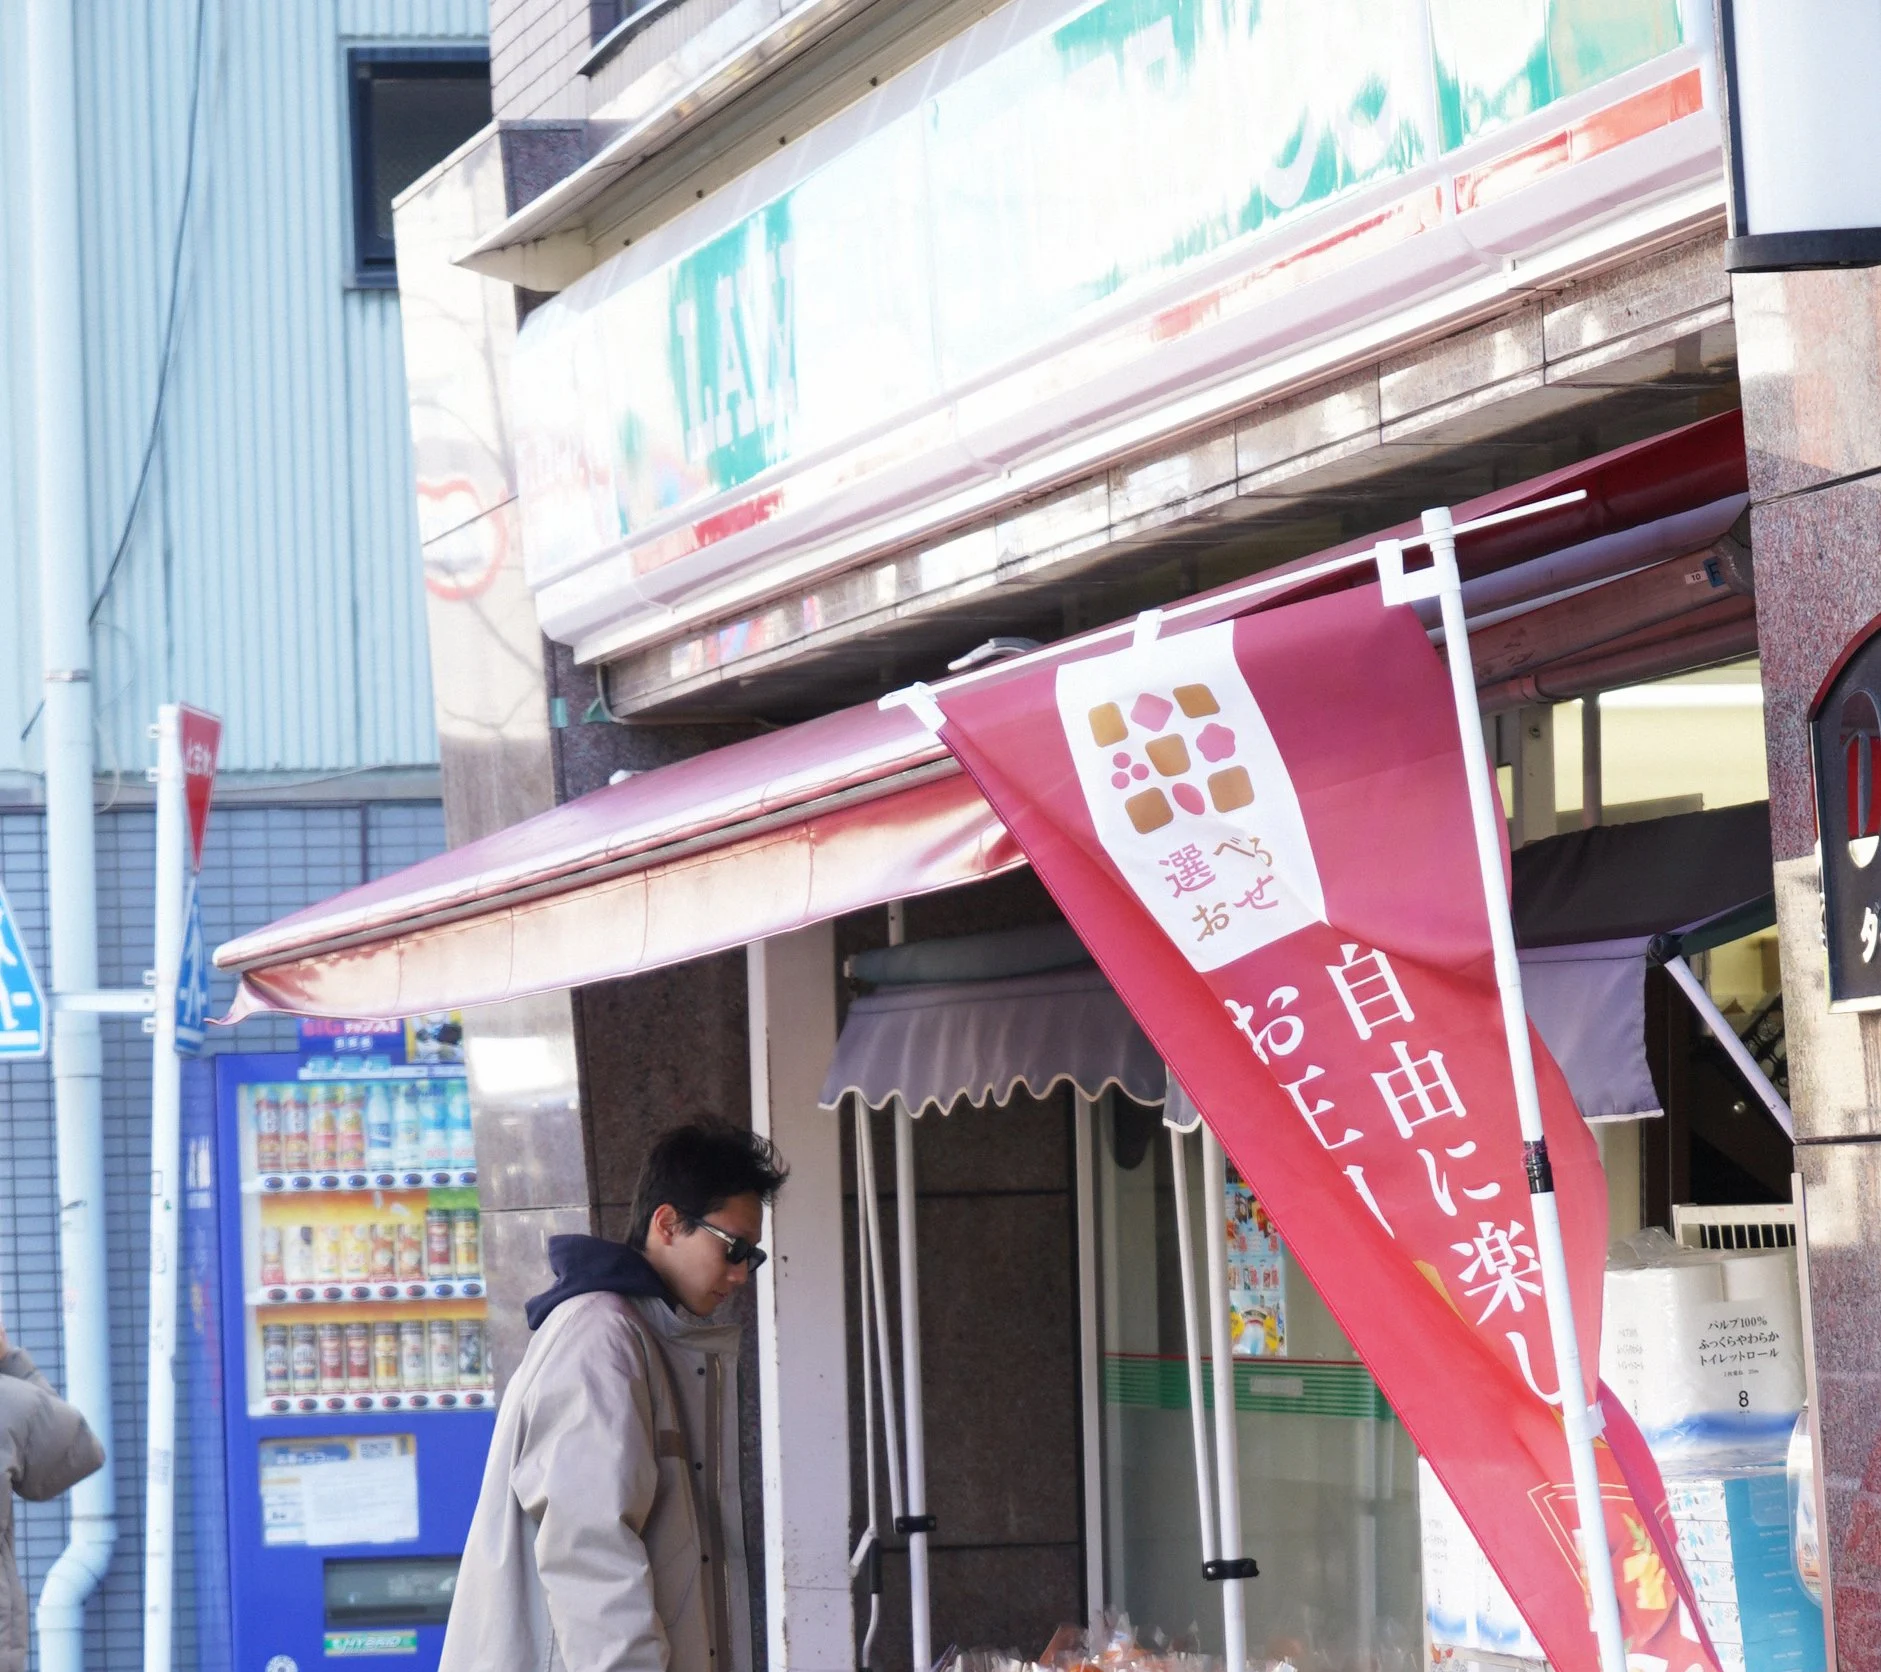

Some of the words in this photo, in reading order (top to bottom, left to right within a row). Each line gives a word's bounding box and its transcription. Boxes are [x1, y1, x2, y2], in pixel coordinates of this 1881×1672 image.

[1708, 1315, 1768, 1331] パルプ100%
[1698, 1331, 1780, 1351] ふっくらやわらか
[1699, 1348, 1780, 1367] トイレットロール
[1738, 1390, 1749, 1408] 8
